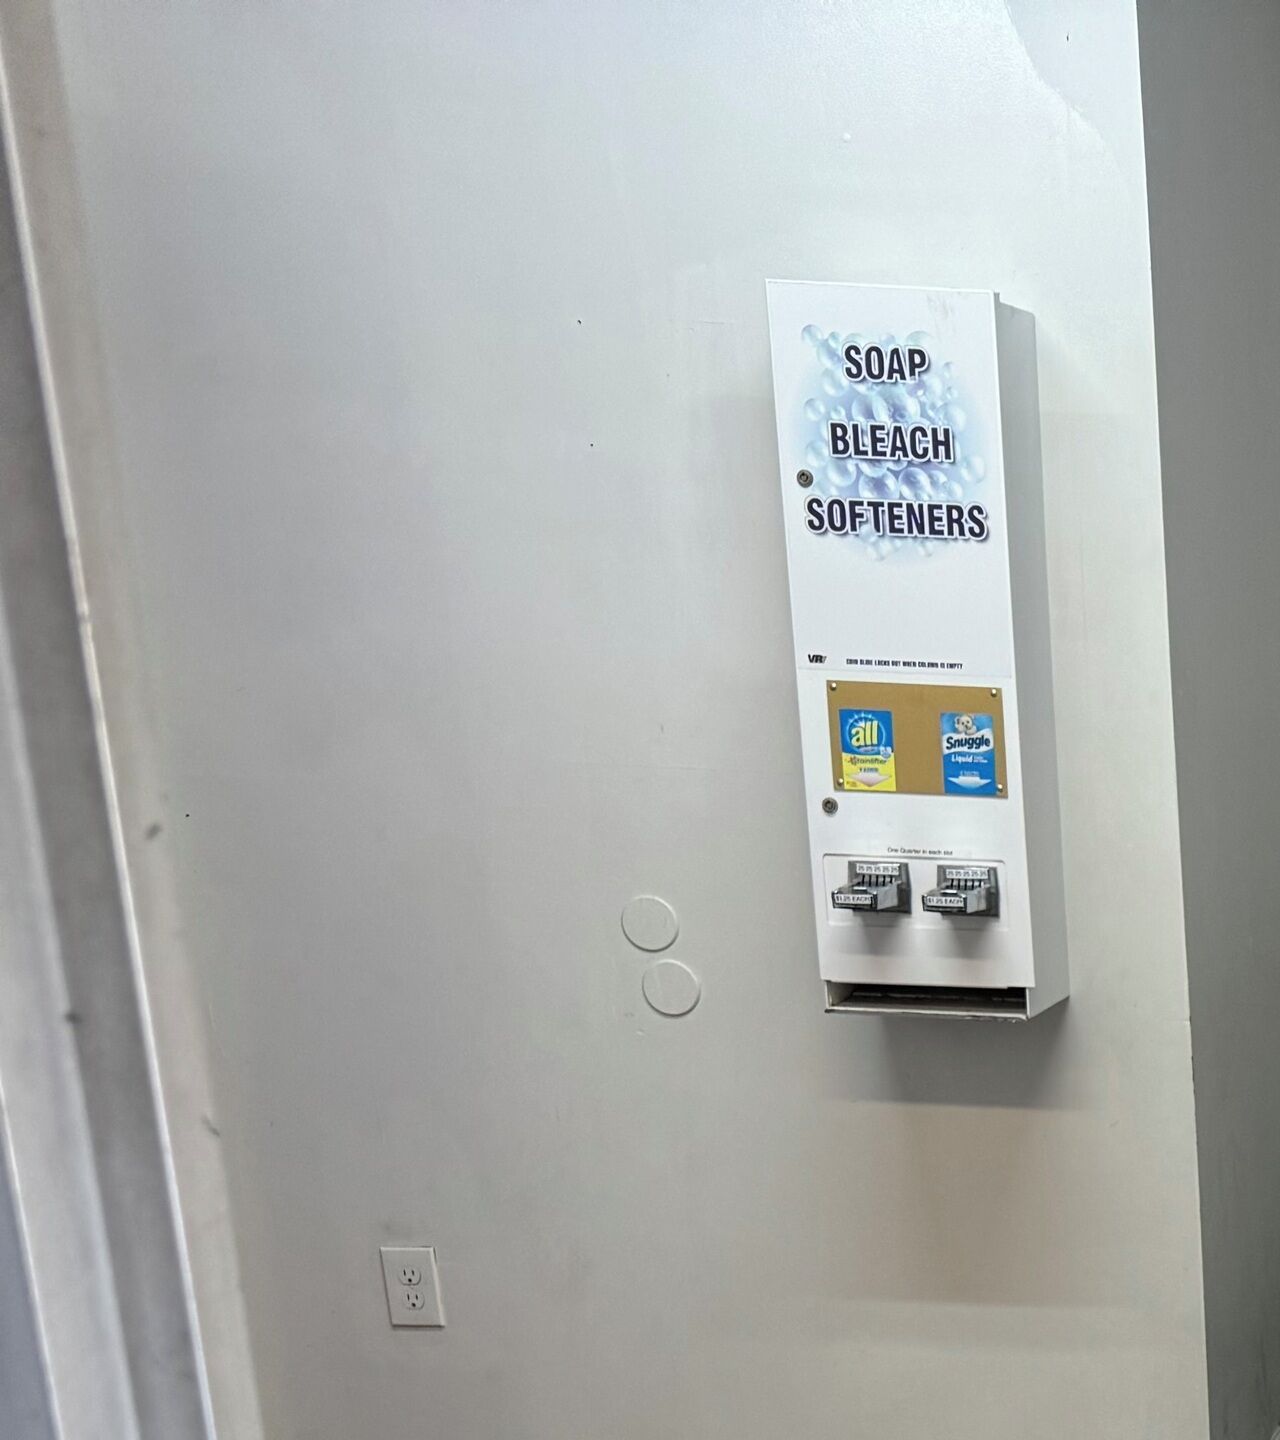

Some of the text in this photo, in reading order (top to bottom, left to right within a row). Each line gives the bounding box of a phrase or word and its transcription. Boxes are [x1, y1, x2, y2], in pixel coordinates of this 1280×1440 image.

[844, 344, 927, 381] SOAP
[830, 422, 953, 461] BLEACH
[806, 498, 986, 539] SOFTENERS
[851, 720, 879, 747] all
[946, 735, 991, 750] Snuggle
[951, 753, 973, 765] Liquid
[888, 846, 899, 854] One
[900, 847, 921, 855] Quarter
